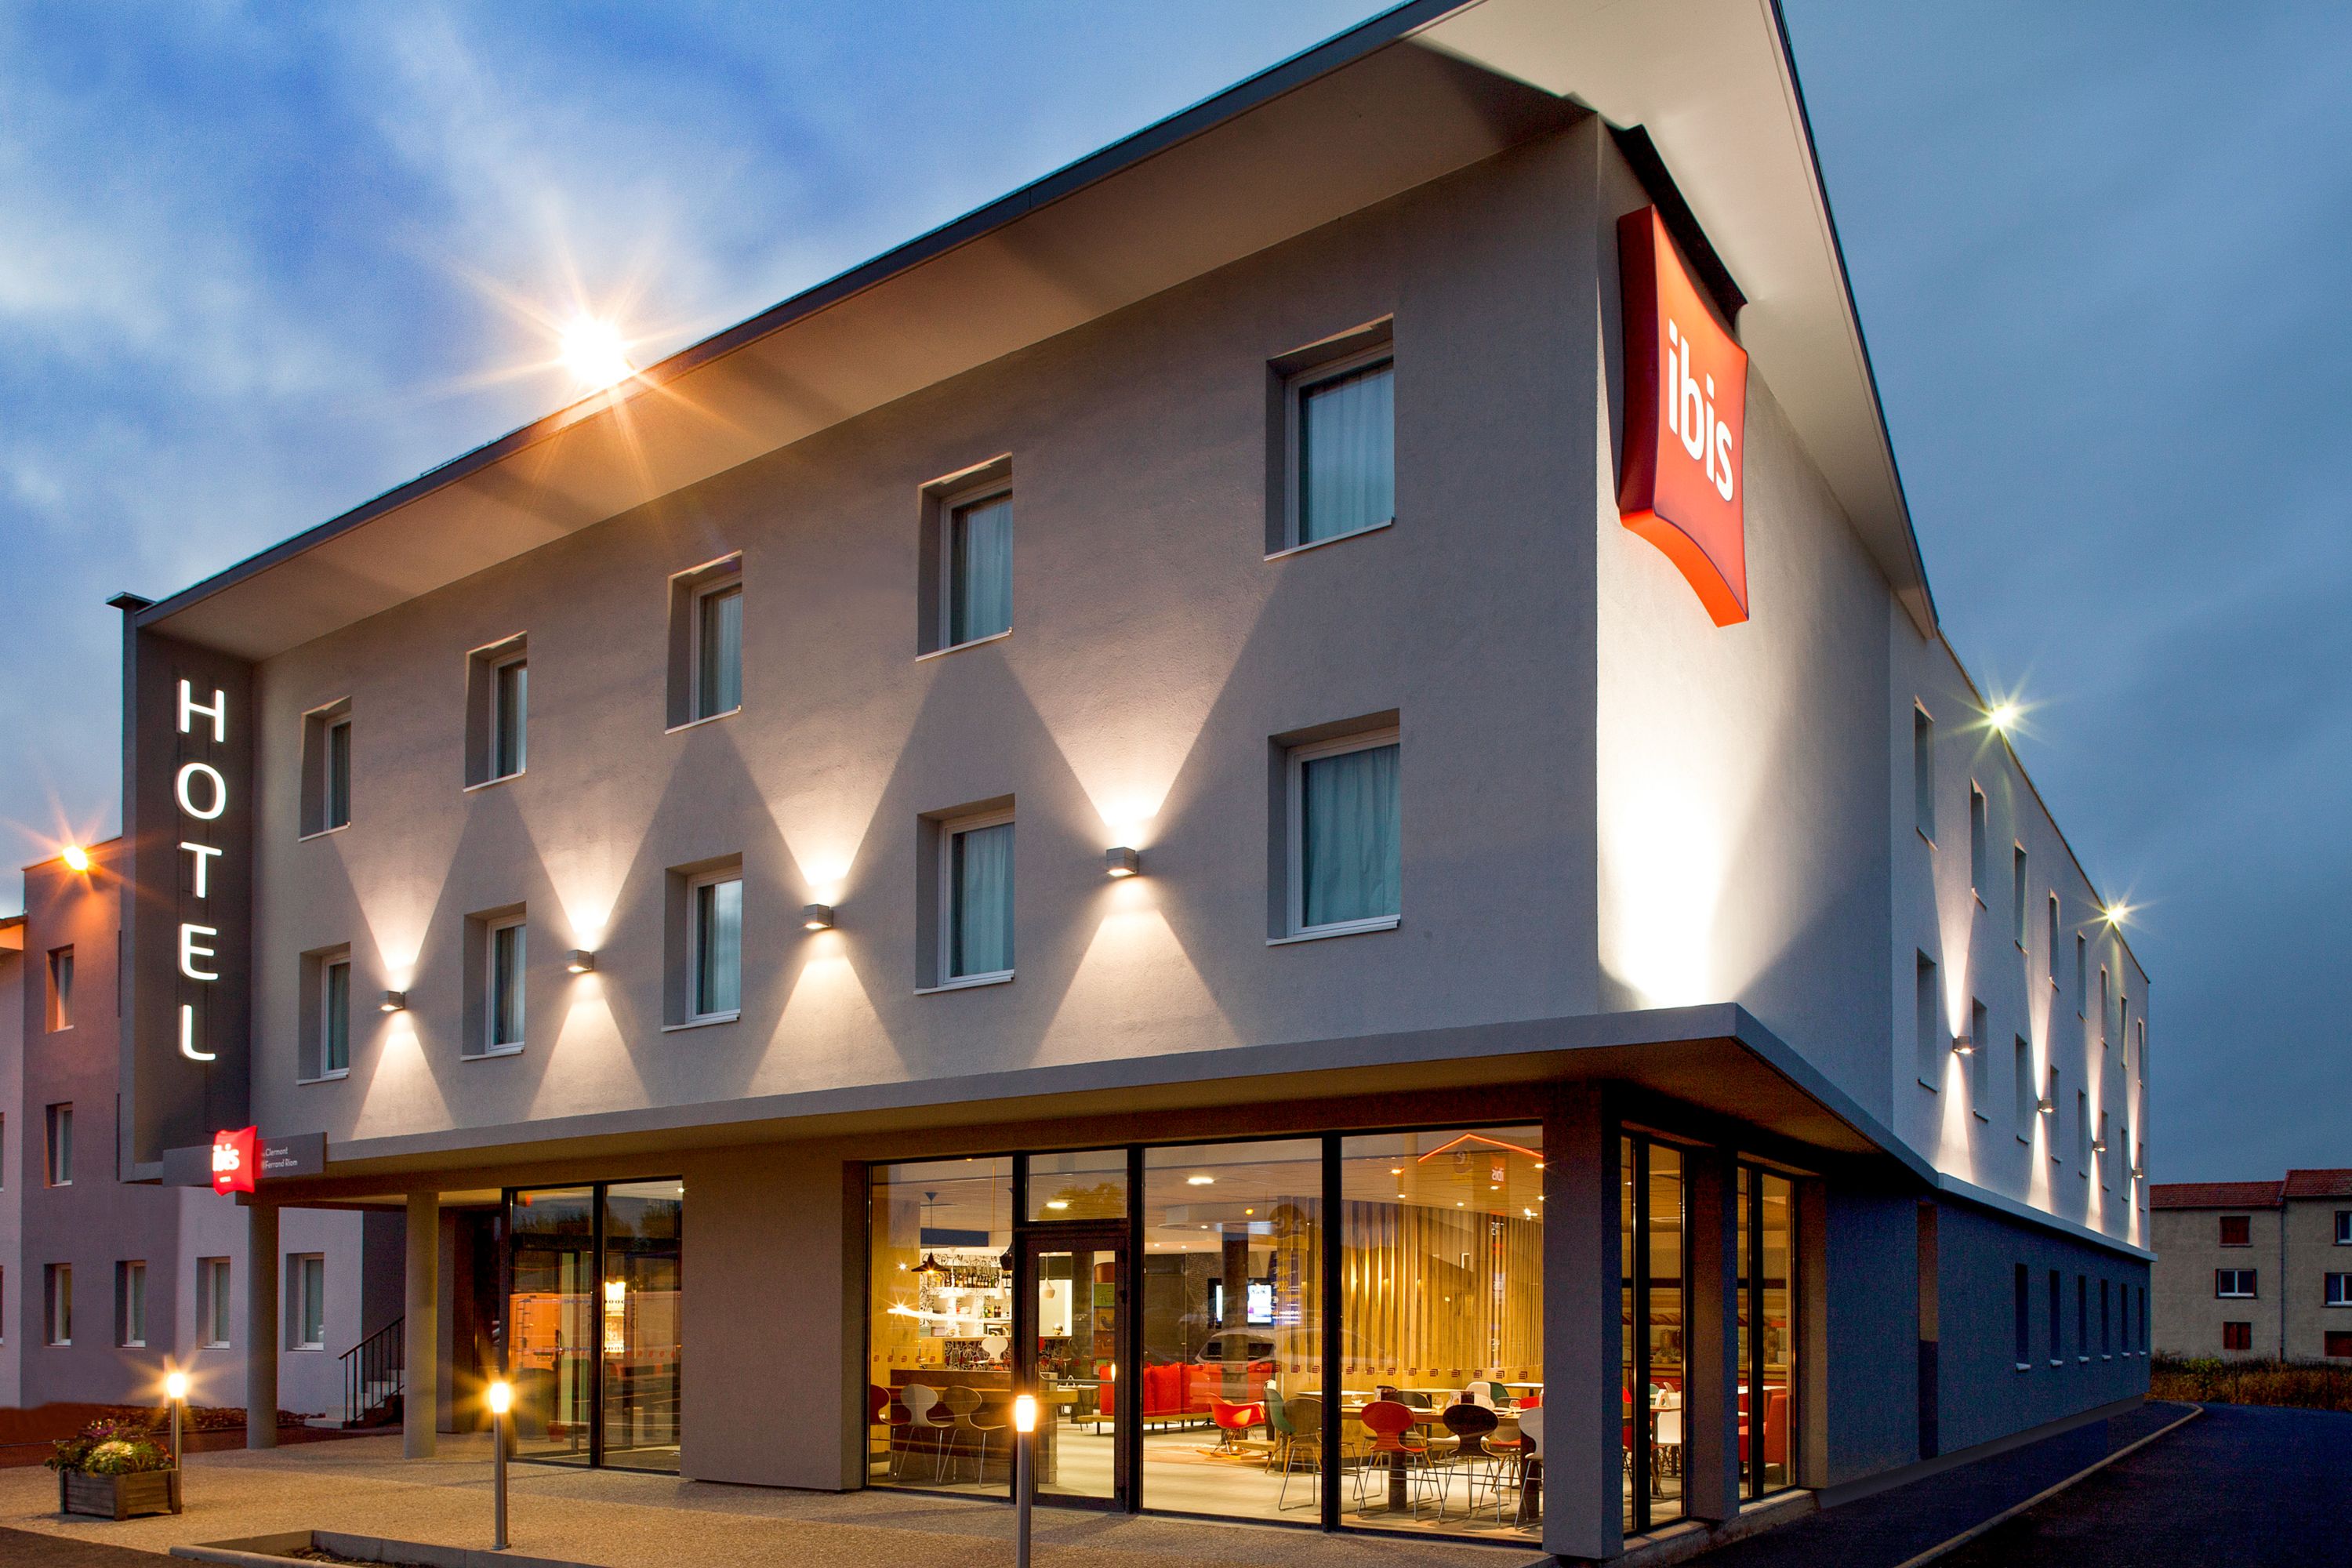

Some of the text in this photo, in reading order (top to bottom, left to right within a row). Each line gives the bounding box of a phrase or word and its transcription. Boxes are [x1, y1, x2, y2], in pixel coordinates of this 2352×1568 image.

[1668, 318, 1733, 502] ibis
[175, 678, 227, 1062] HOTEL
[212, 1143, 240, 1172] ibis
[265, 1146, 289, 1156] Clermont
[265, 1158, 298, 1168] Ferrand Riom
